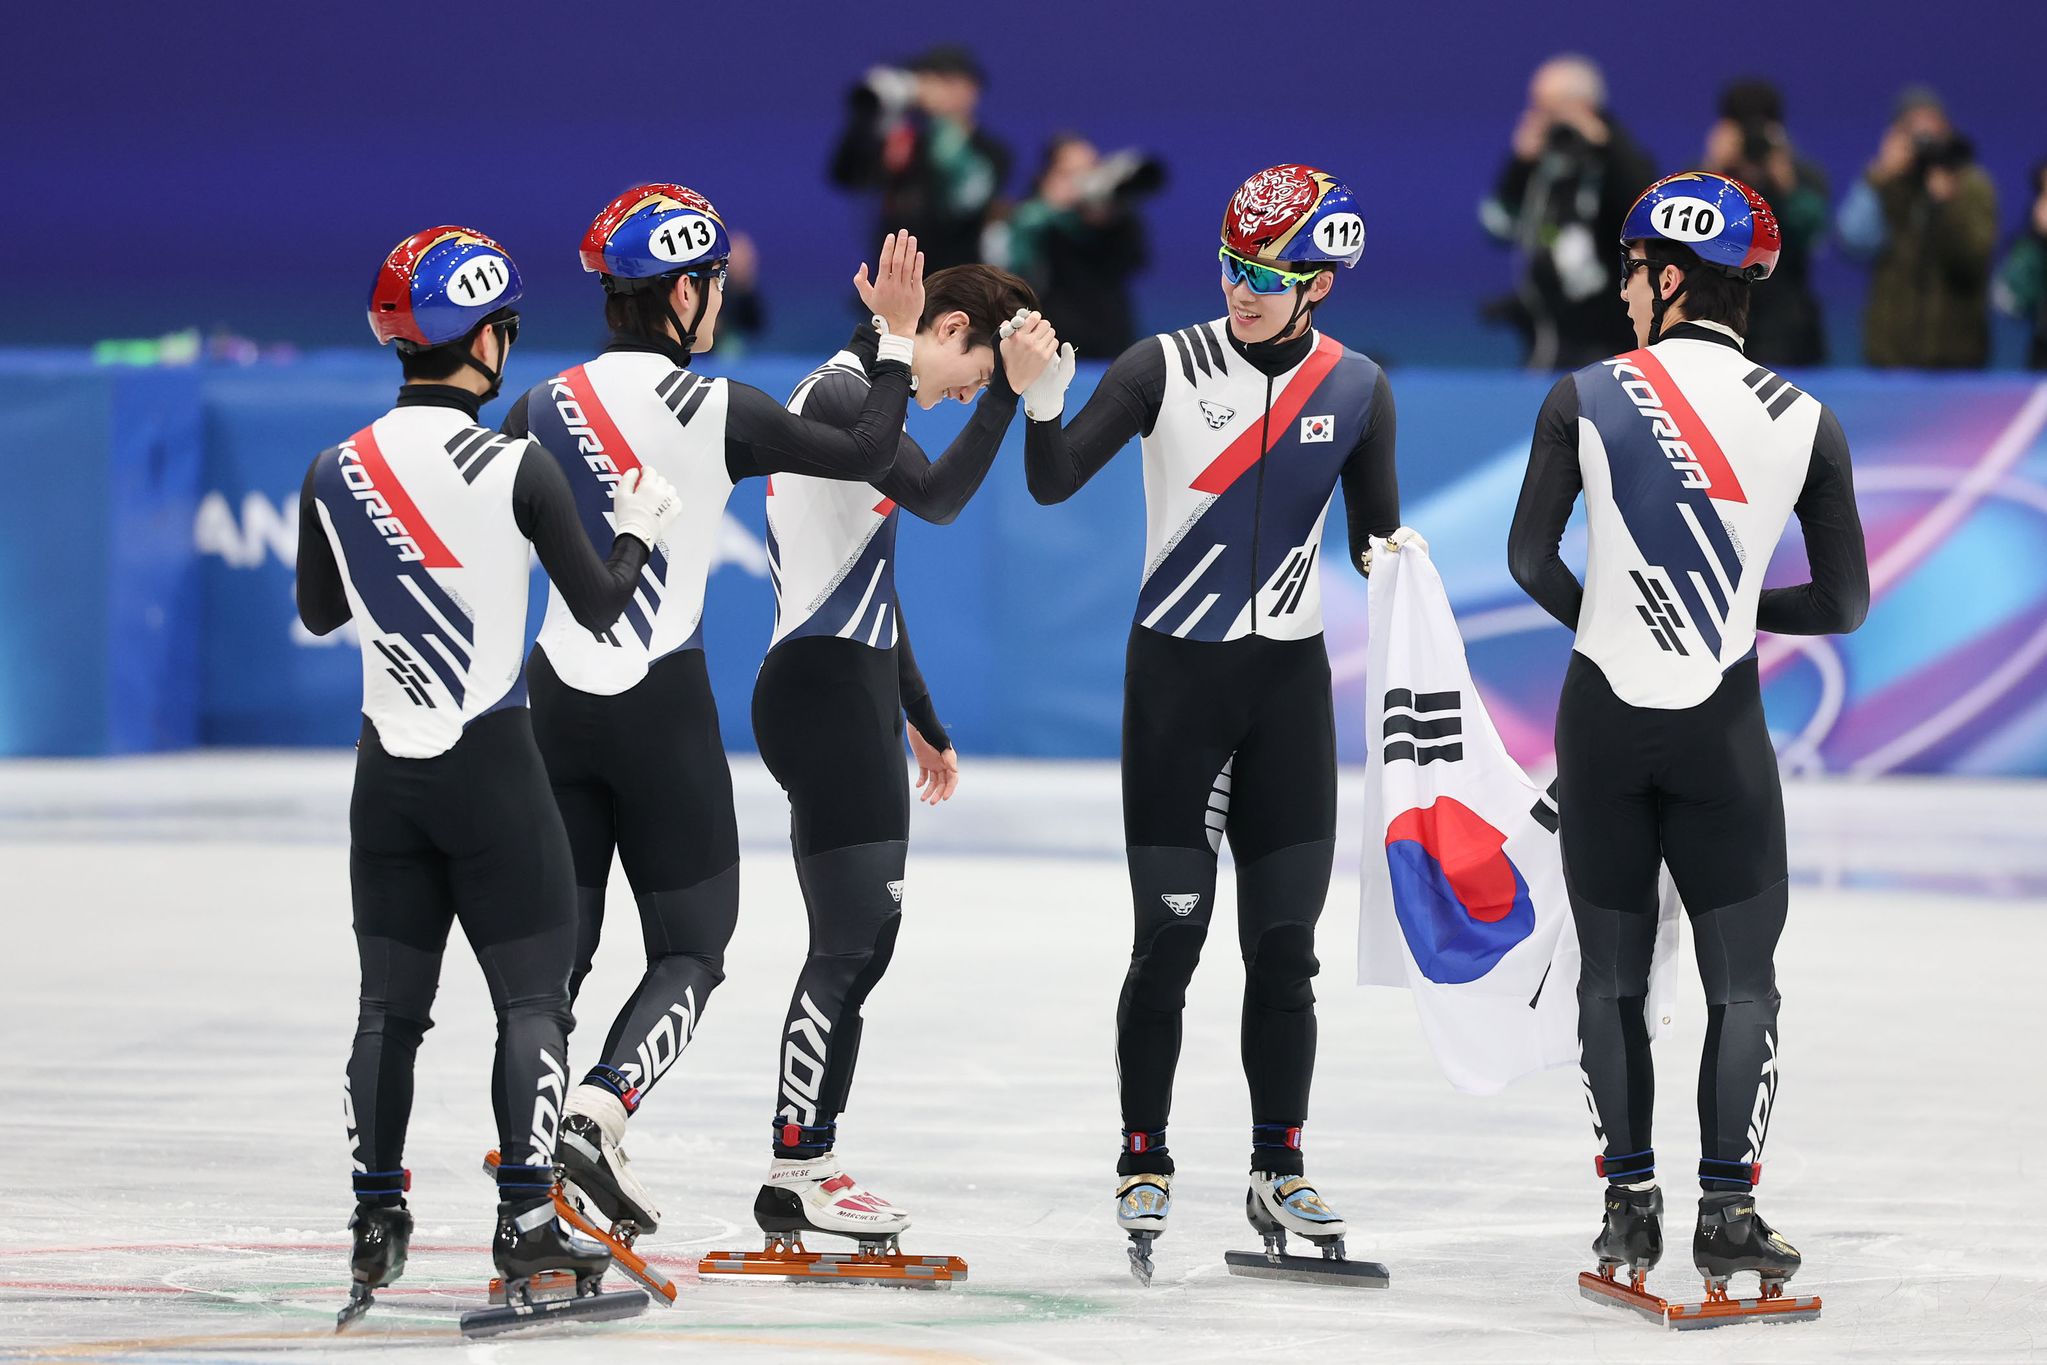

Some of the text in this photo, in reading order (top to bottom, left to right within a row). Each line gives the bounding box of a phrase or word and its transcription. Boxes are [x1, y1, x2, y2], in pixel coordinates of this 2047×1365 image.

[1324, 220, 1361, 248] 112
[1661, 203, 1715, 236] 110
[660, 221, 710, 256] 113
[458, 259, 503, 299] 111
[1601, 358, 1712, 489] KOREA
[338, 440, 426, 562] KOREA
[837, 1210, 879, 1222] MARCHESE
